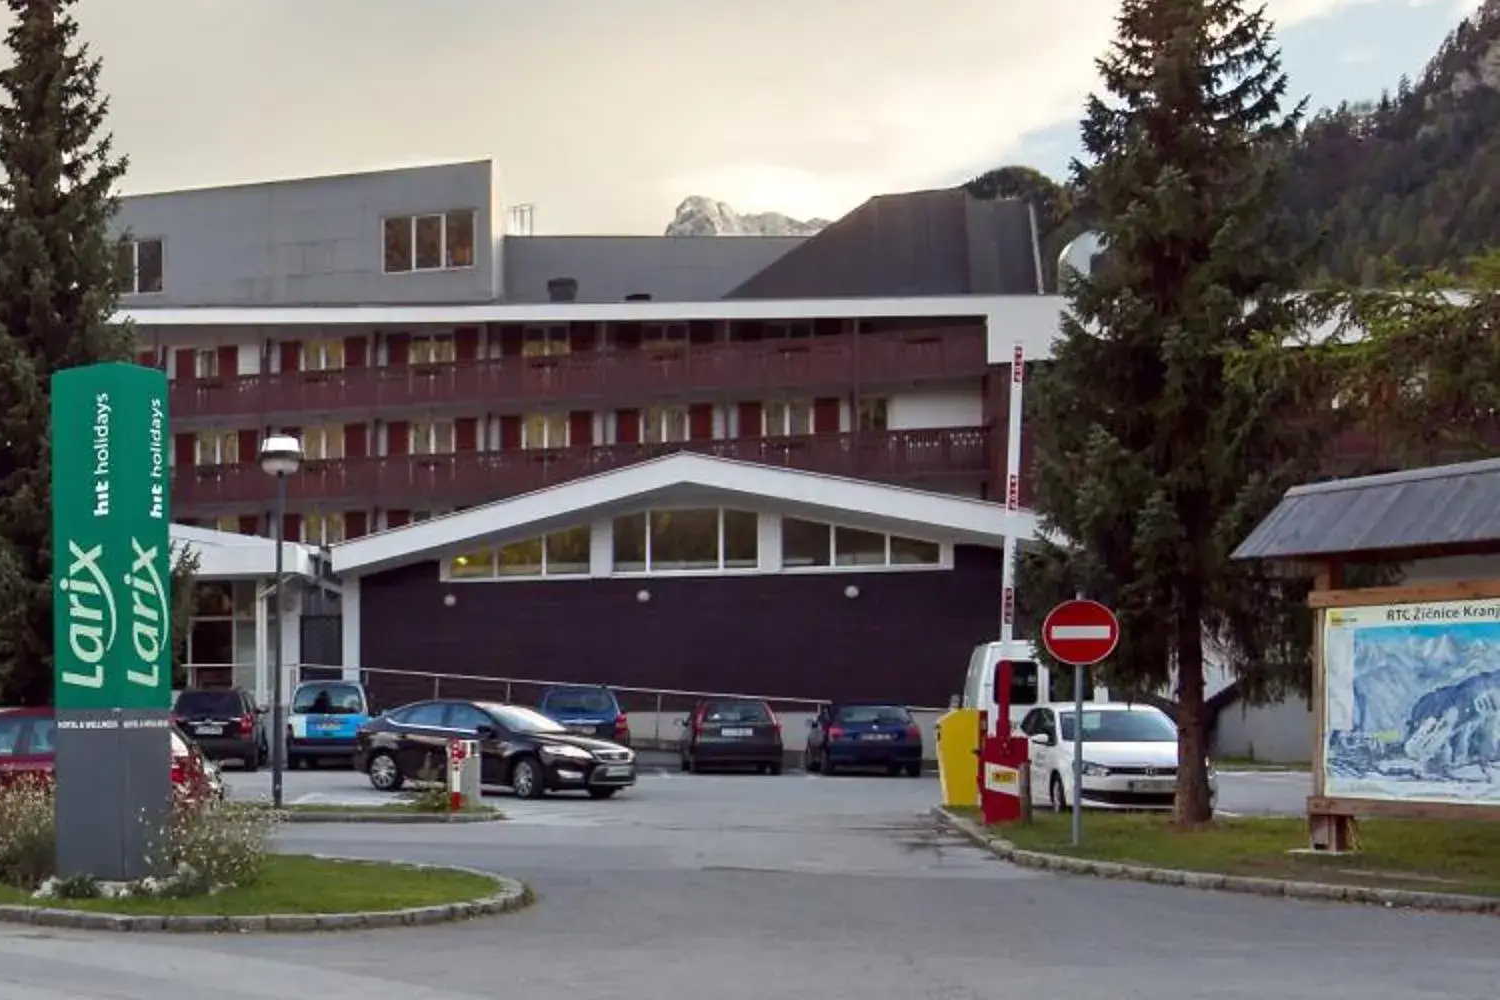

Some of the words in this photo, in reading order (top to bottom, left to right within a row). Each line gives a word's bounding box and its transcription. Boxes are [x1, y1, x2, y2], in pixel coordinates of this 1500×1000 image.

[93, 393, 112, 475] holidays
[149, 398, 164, 477] holidays
[94, 481, 109, 516] hit
[150, 484, 162, 519] hit
[60, 539, 117, 689] Larix
[124, 536, 169, 687] Larix
